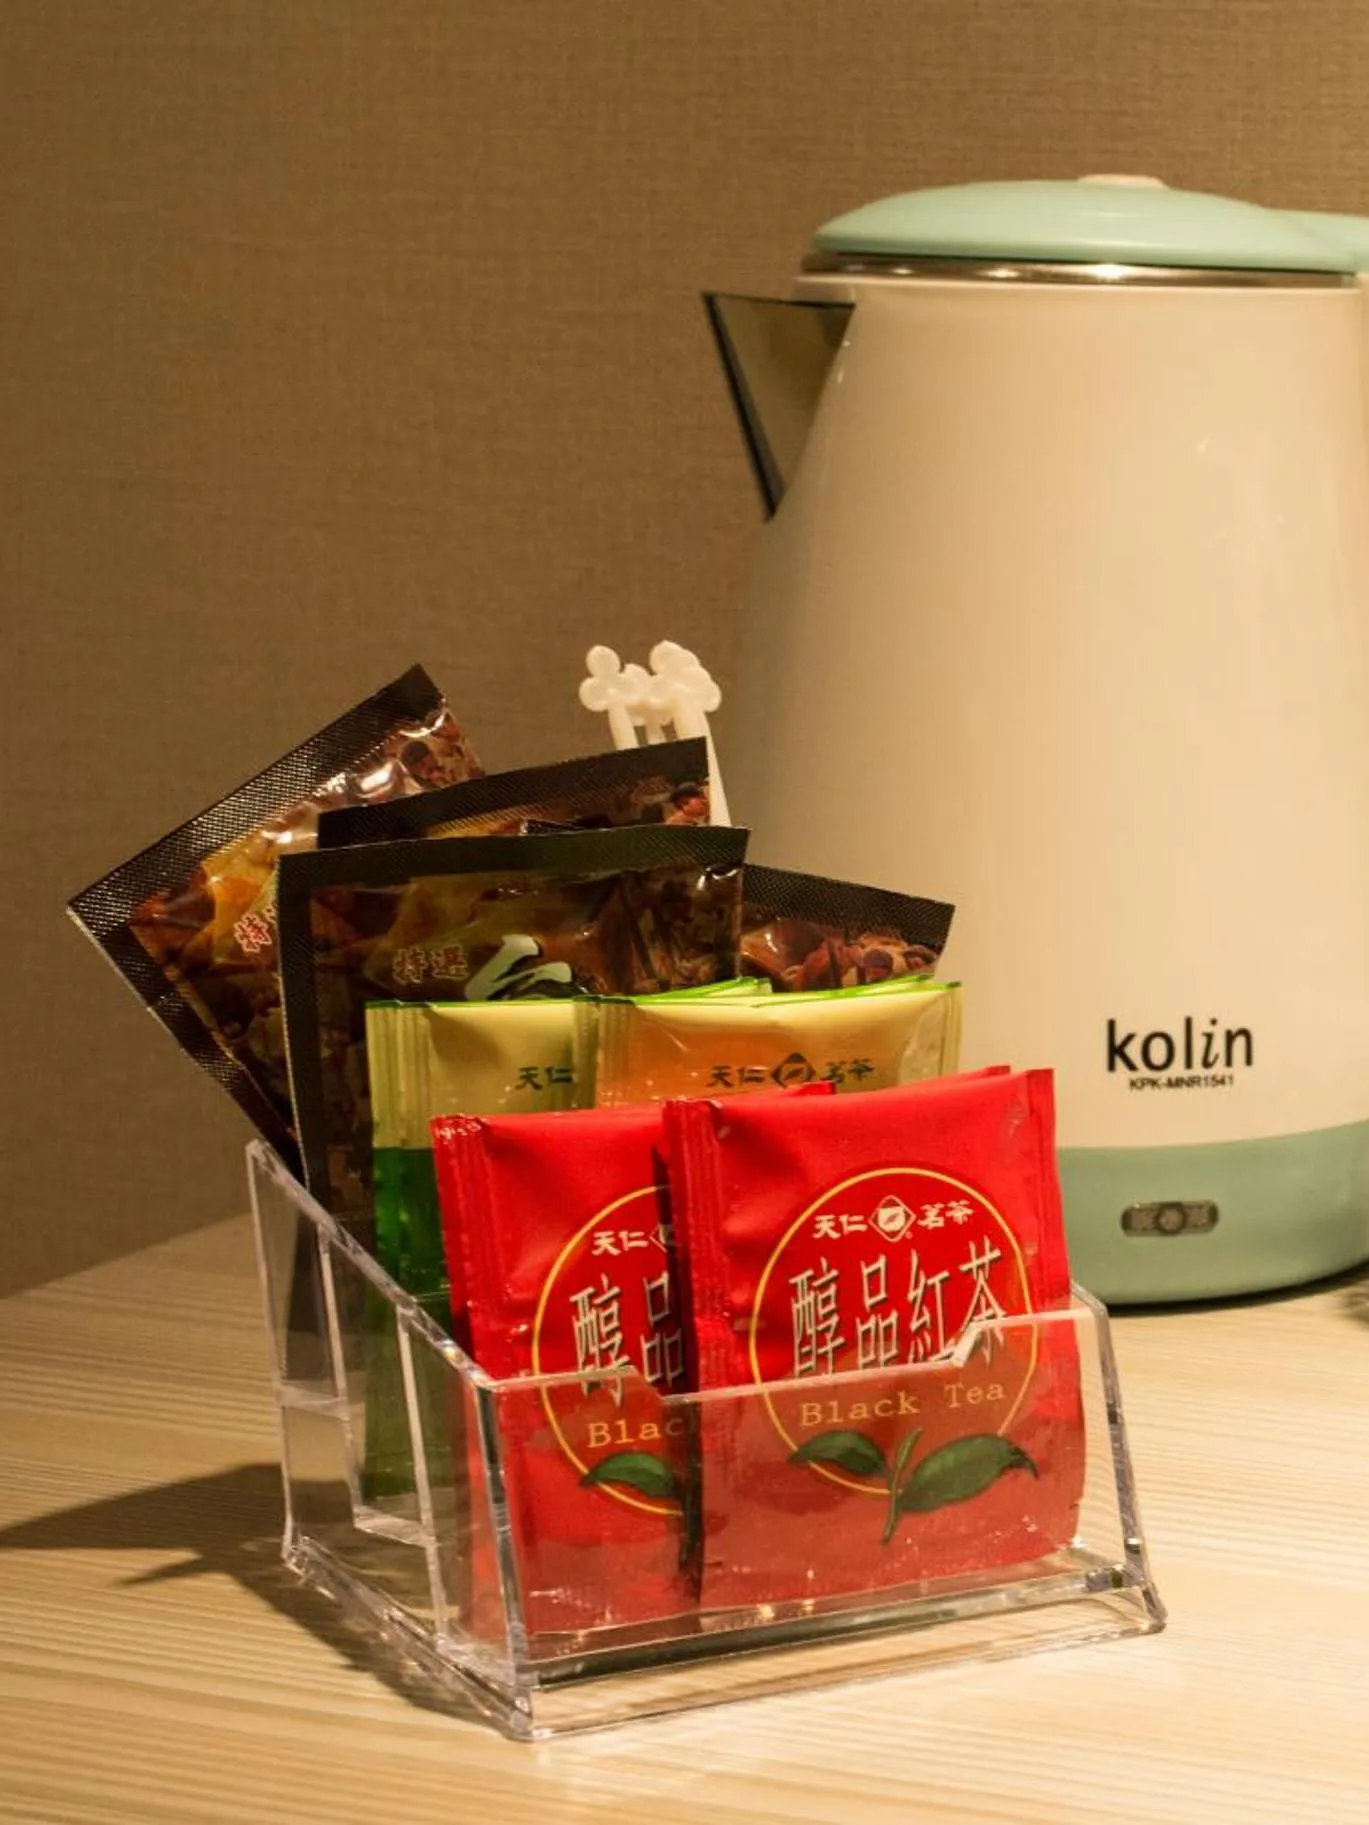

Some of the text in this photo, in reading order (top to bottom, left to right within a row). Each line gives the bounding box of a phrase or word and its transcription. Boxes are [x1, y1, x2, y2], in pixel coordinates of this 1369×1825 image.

[1106, 1016, 1254, 1073] kolin
[515, 1066, 575, 1091] 天仁
[706, 1065, 767, 1089] 天仁
[811, 1200, 974, 1240] 天仁 茗茶
[592, 1230, 649, 1256] 天仁
[789, 1235, 1007, 1378] 醇品紅茶
[800, 1383, 1004, 1427] Black Tea
